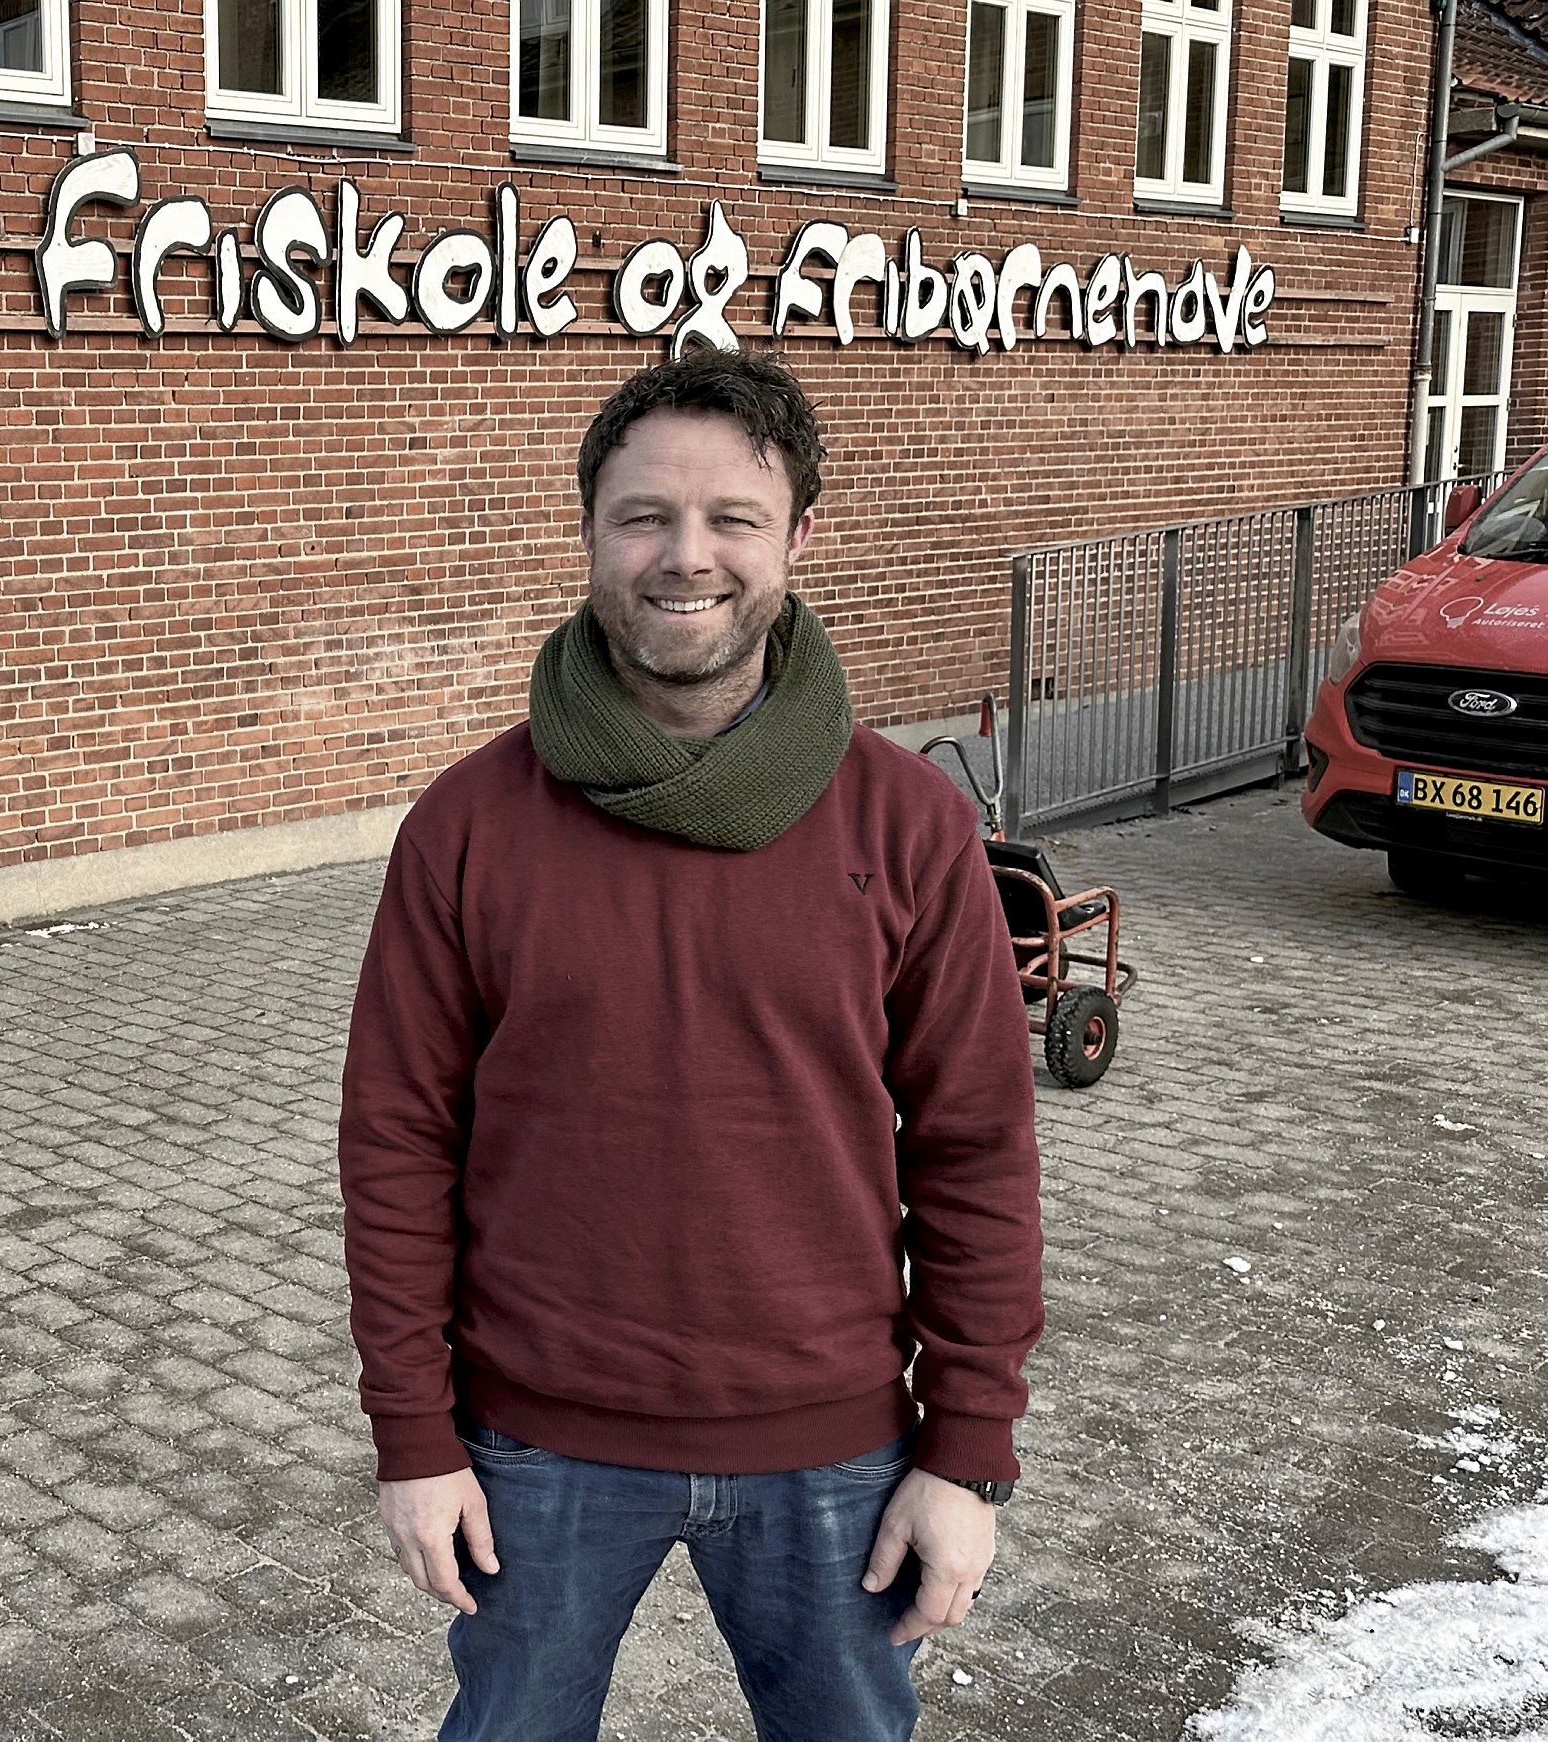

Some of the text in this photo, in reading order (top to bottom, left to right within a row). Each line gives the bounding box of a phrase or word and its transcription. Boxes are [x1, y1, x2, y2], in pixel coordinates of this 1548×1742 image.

[613, 198, 749, 362] og
[1471, 618, 1545, 629] Autoriseret
[1459, 692, 1498, 710] Ford
[1413, 777, 1539, 817] BX 68 146
